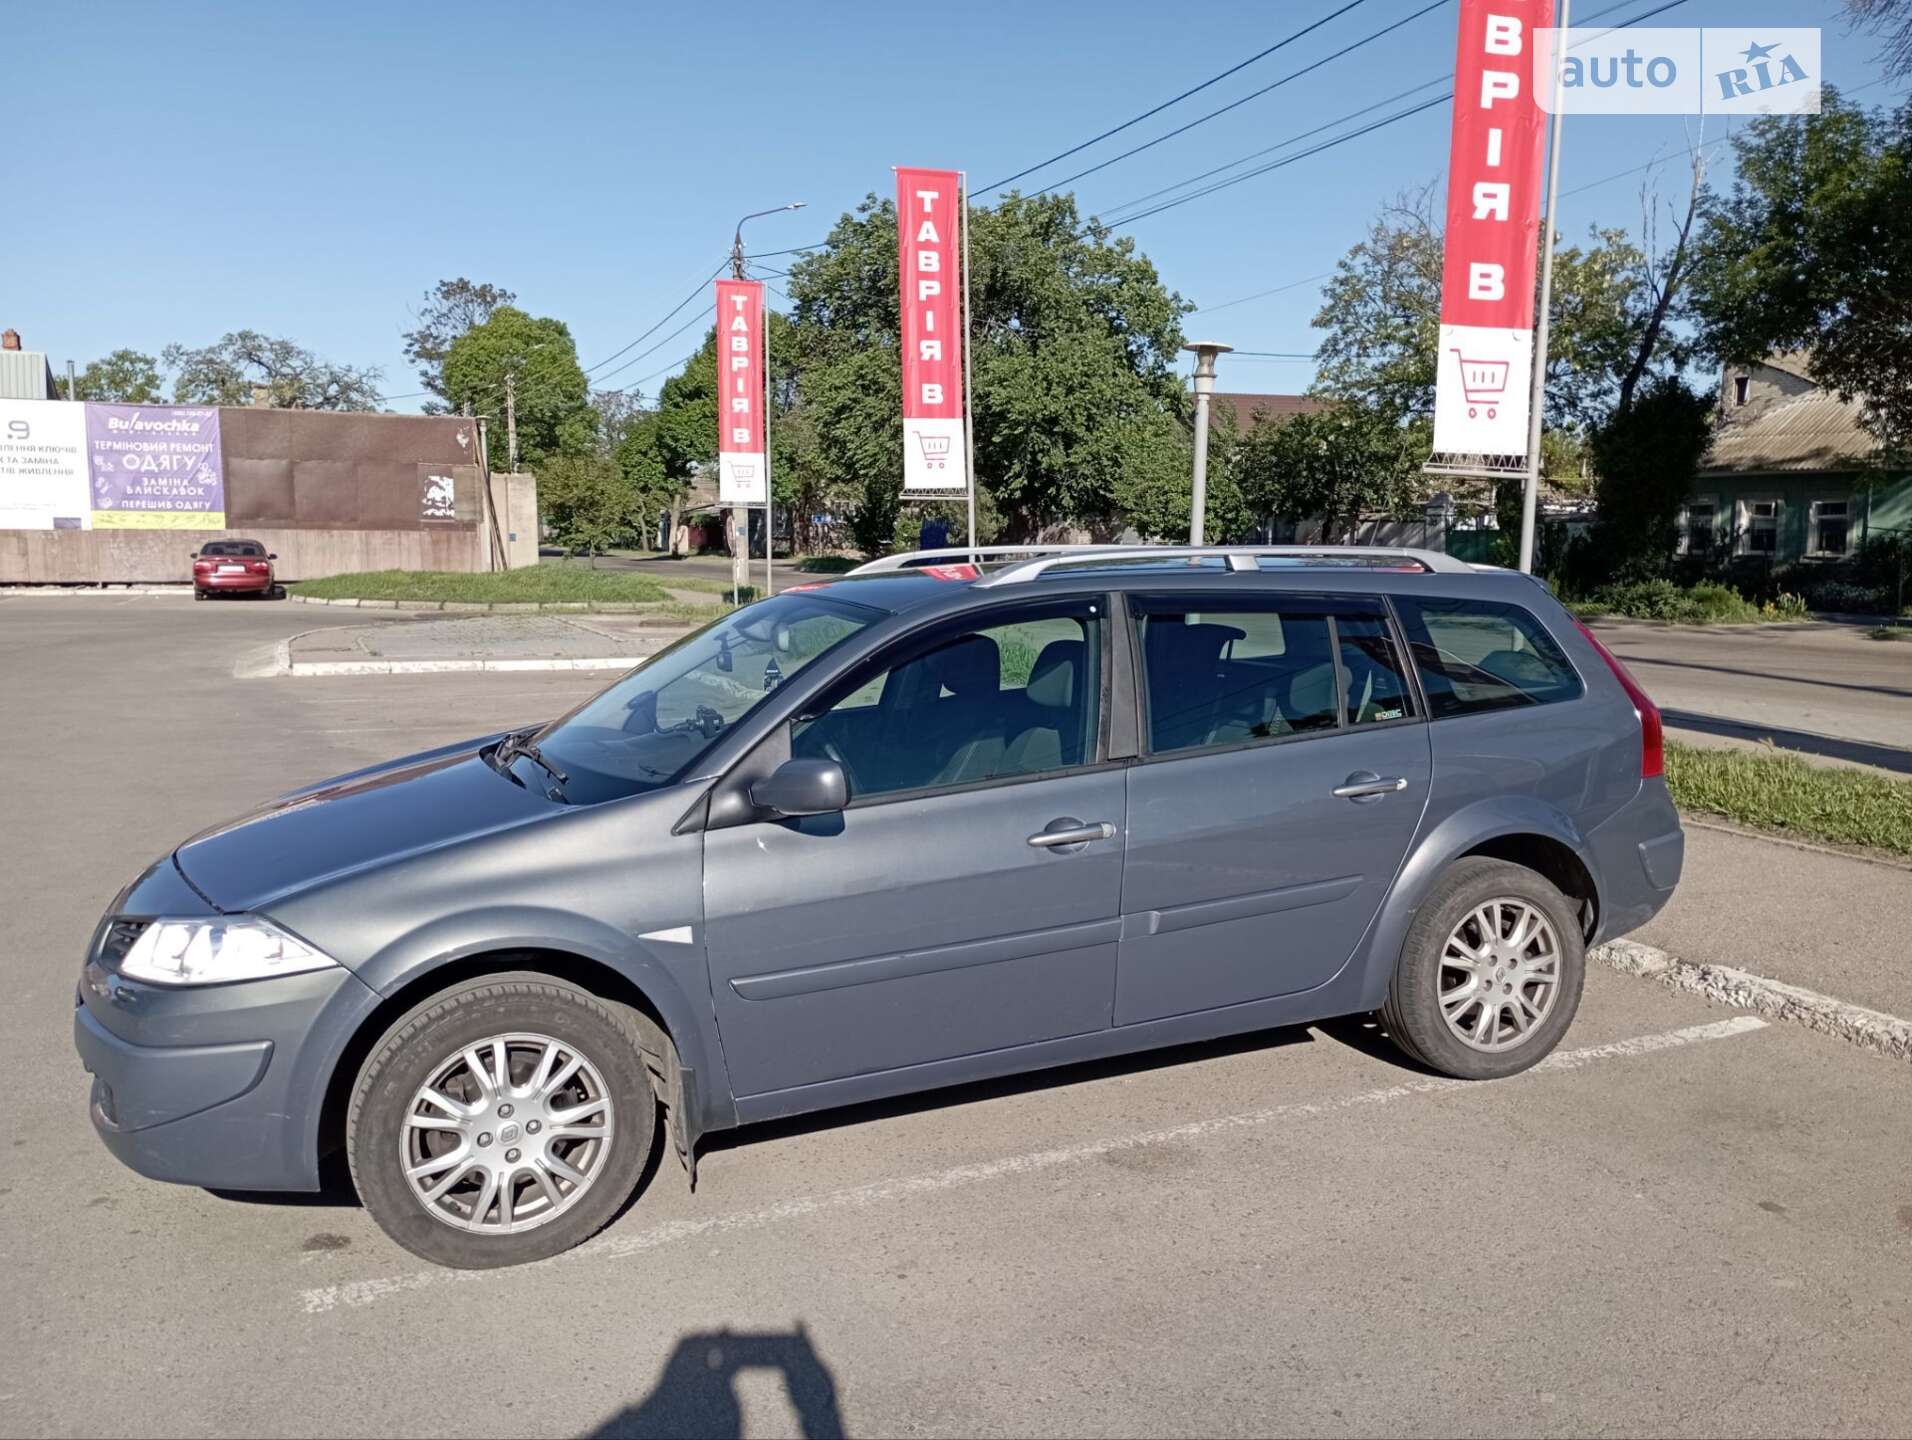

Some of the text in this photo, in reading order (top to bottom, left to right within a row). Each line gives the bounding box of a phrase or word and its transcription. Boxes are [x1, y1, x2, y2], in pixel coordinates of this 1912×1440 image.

[1467, 0, 1524, 302] ВРІЯ В
[916, 190, 944, 405] ТАВРІЯ В
[730, 295, 750, 444] ТАВРІЯ В
[108, 411, 201, 434] Bulavochka
[94, 440, 214, 453] ТЕРМІНОВИЙ РЕМОНТ
[122, 453, 197, 473] ОДЯГУ
[126, 486, 205, 496] БЛИСКАВОК
[142, 477, 190, 487] ЗАМІНА
[175, 501, 212, 511] ОДЯГУ
